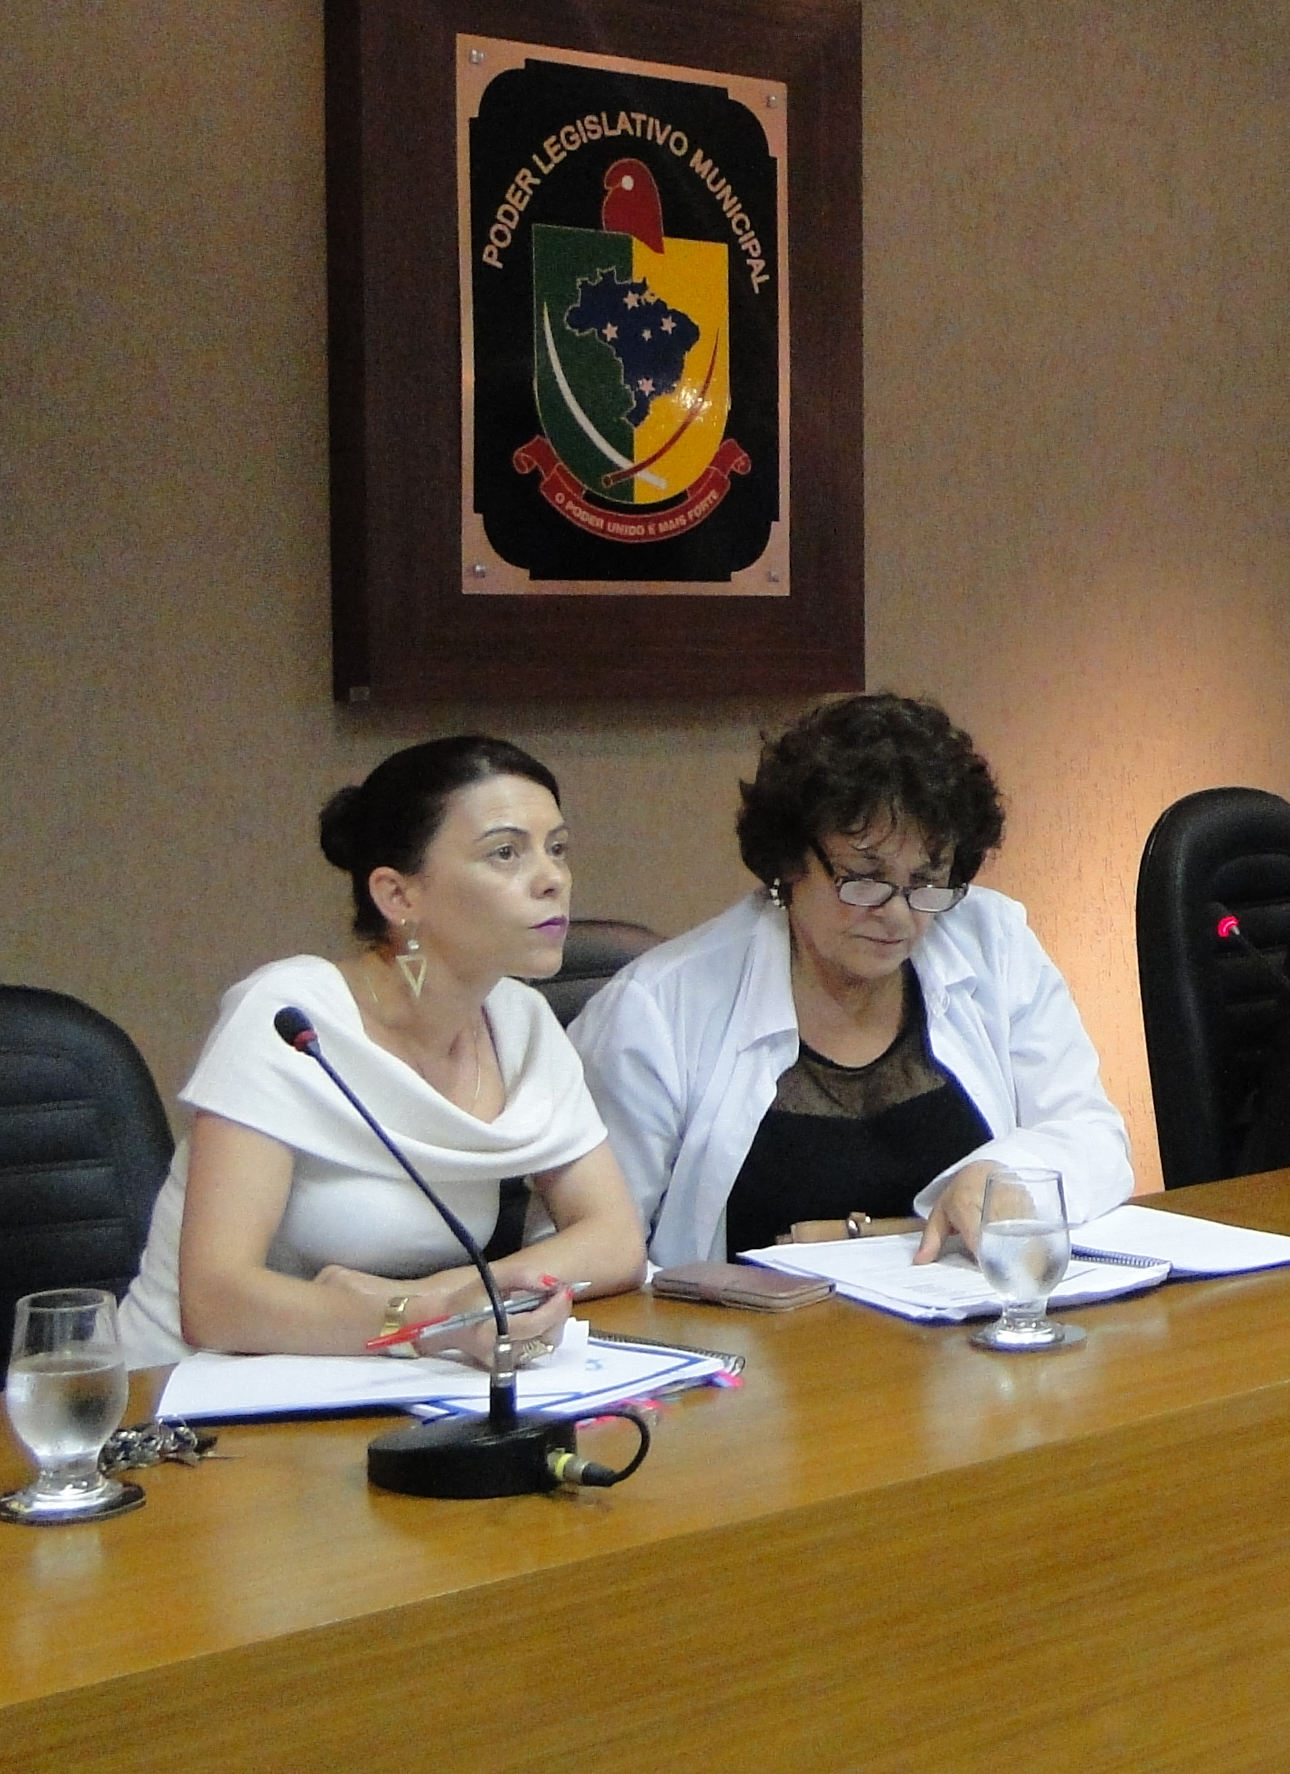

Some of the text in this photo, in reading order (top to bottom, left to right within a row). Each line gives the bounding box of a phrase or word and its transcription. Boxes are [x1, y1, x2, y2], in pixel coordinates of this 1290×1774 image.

[482, 111, 770, 294] PODER LEGISLATIVO MUNICIPAL
[555, 493, 566, 505] O
[565, 500, 603, 529] PODER
[608, 521, 645, 536] UNIDO
[658, 514, 687, 534] MAIS
[687, 489, 719, 521] FORTE
